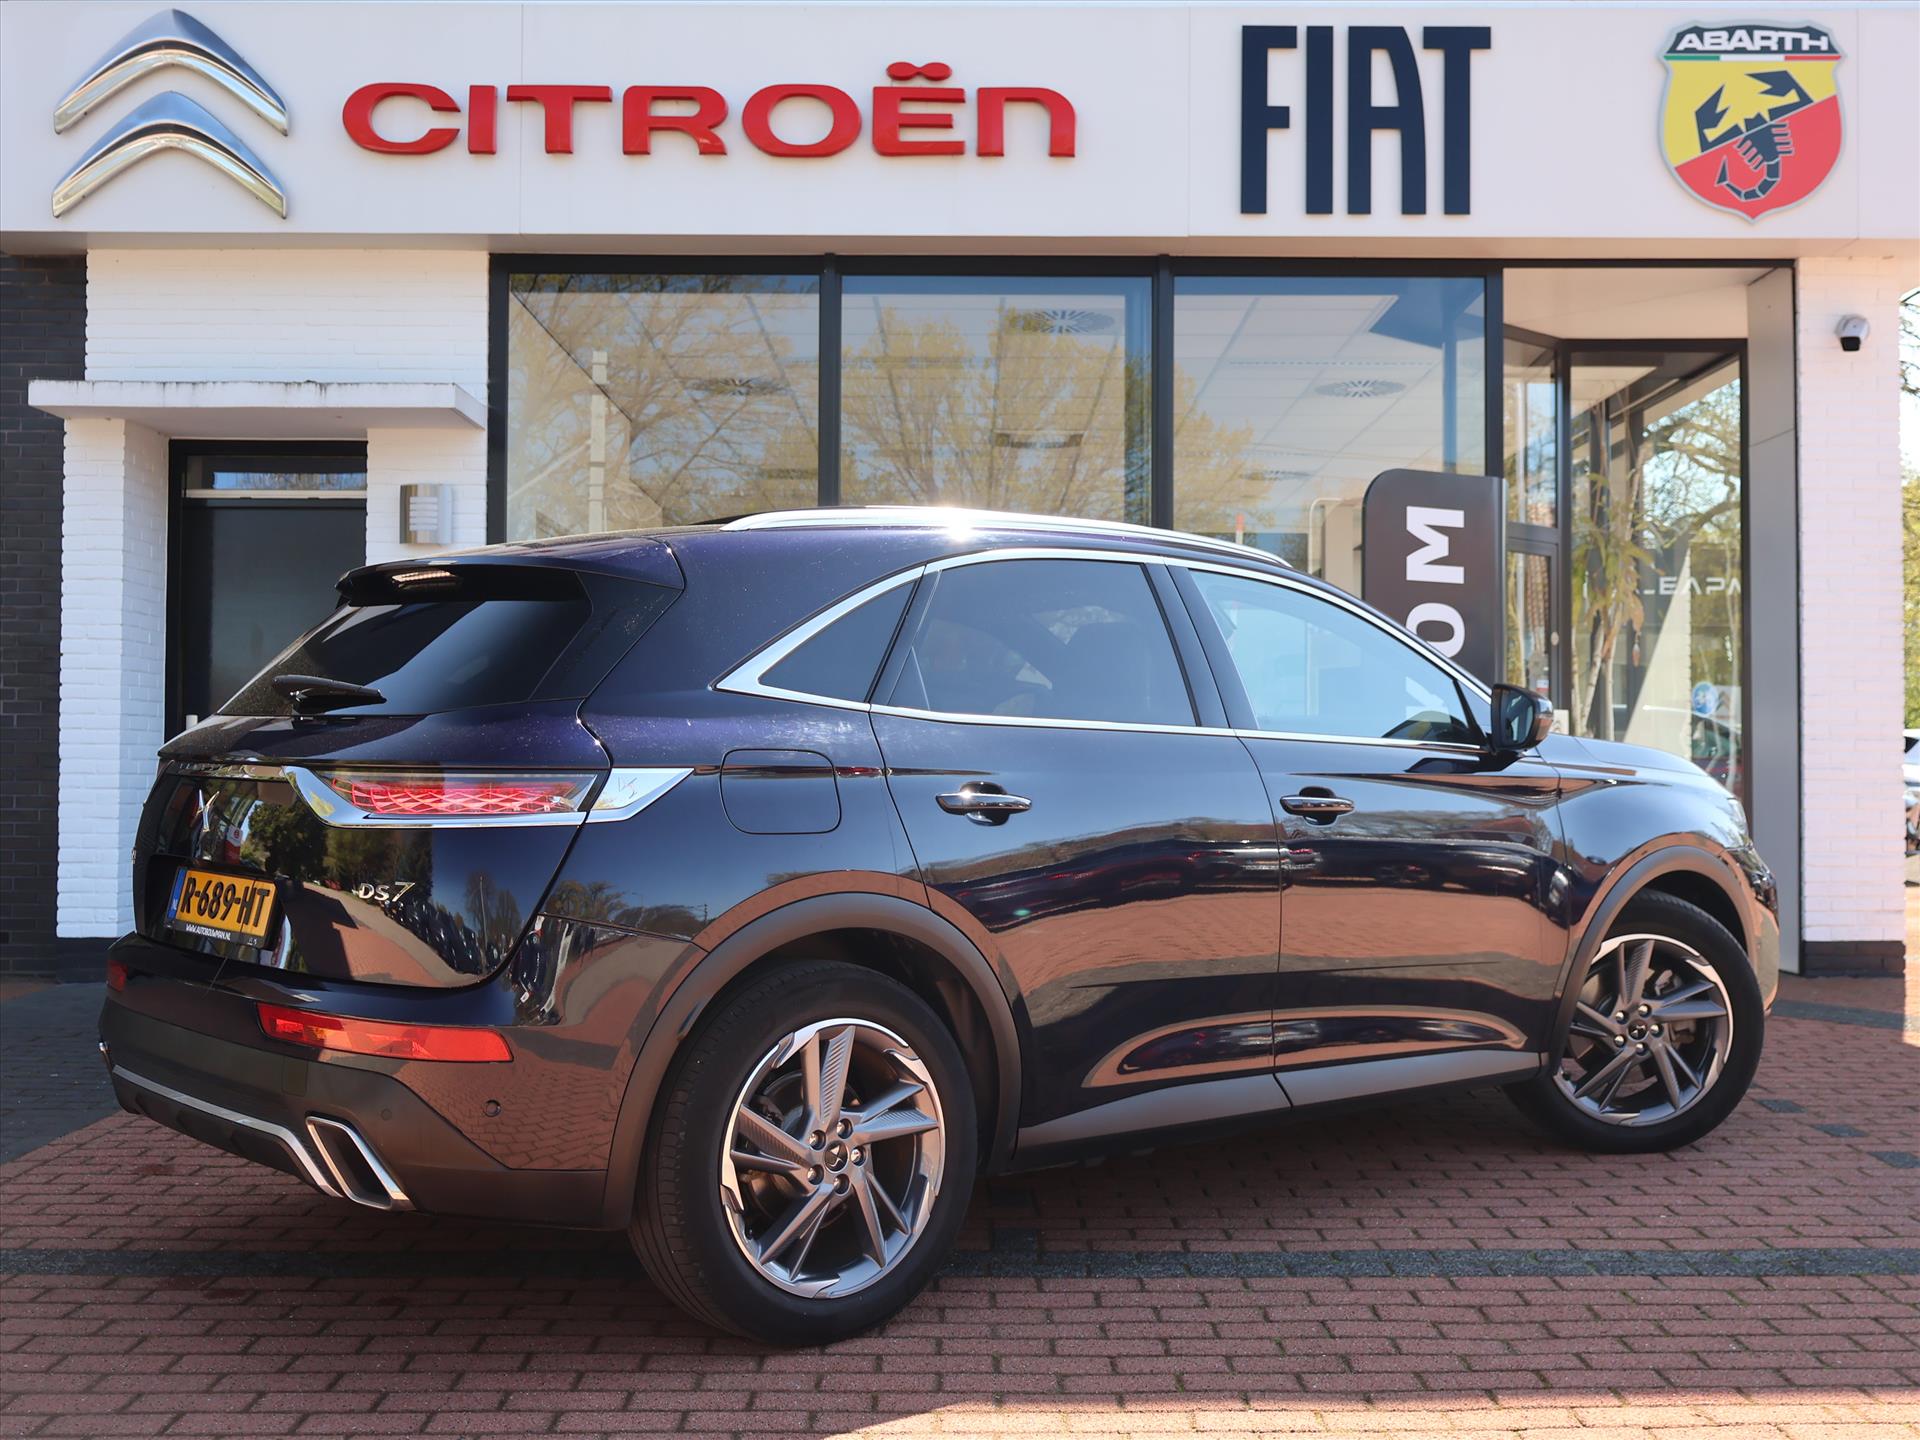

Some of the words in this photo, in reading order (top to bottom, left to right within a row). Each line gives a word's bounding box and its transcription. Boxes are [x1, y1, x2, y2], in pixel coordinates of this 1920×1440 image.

[1675, 29, 1829, 51] ABARTH
[342, 62, 1077, 157] CITROËN
[1241, 25, 1491, 215] FIAT
[180, 877, 270, 928] R-689-HT
